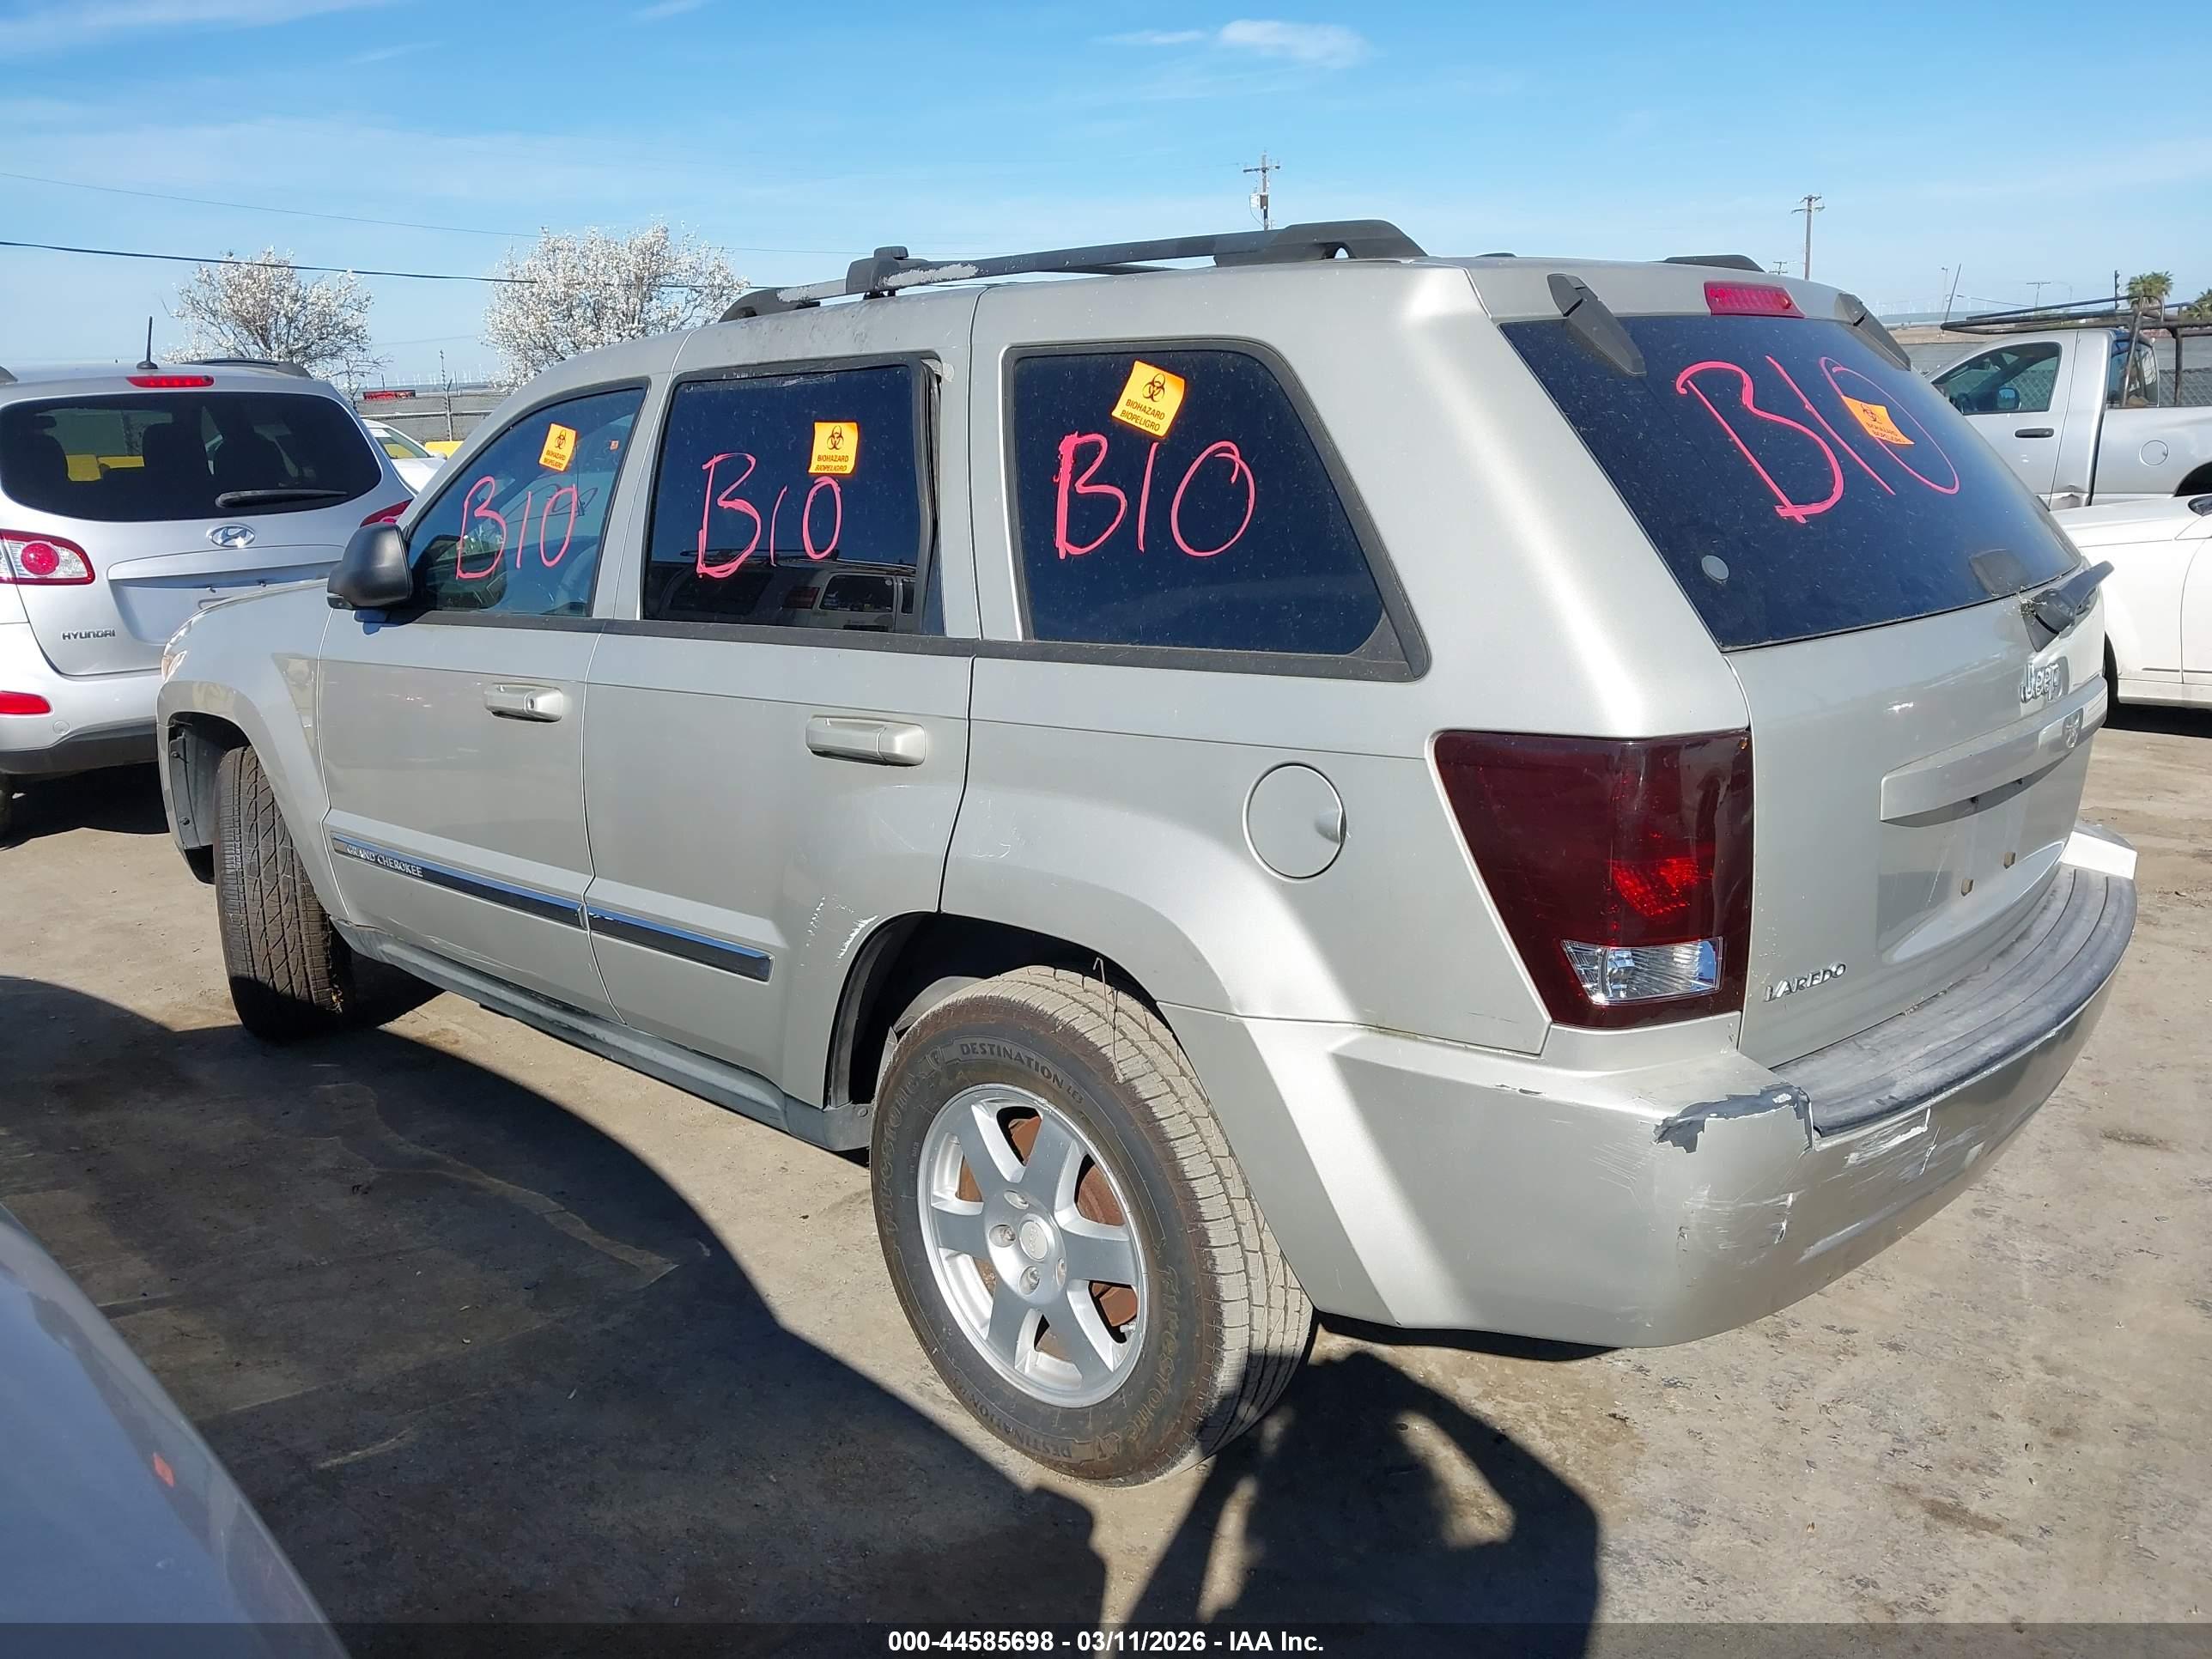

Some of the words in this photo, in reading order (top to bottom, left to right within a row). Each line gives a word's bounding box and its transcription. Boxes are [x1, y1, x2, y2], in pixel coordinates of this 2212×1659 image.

[1120, 409, 1160, 432] BIOPELIGRO
[1125, 398, 1165, 421] BIOHAZARD
[817, 454, 849, 463] BIOHAZARD
[62, 629, 116, 641] HYUNDAI
[2020, 662, 2061, 703] Jeep
[346, 844, 376, 862] GRAND
[377, 854, 423, 878] CHEROKEE
[1764, 963, 1846, 1003] LAREDO
[959, 1042, 1065, 1090] DESTINATION
